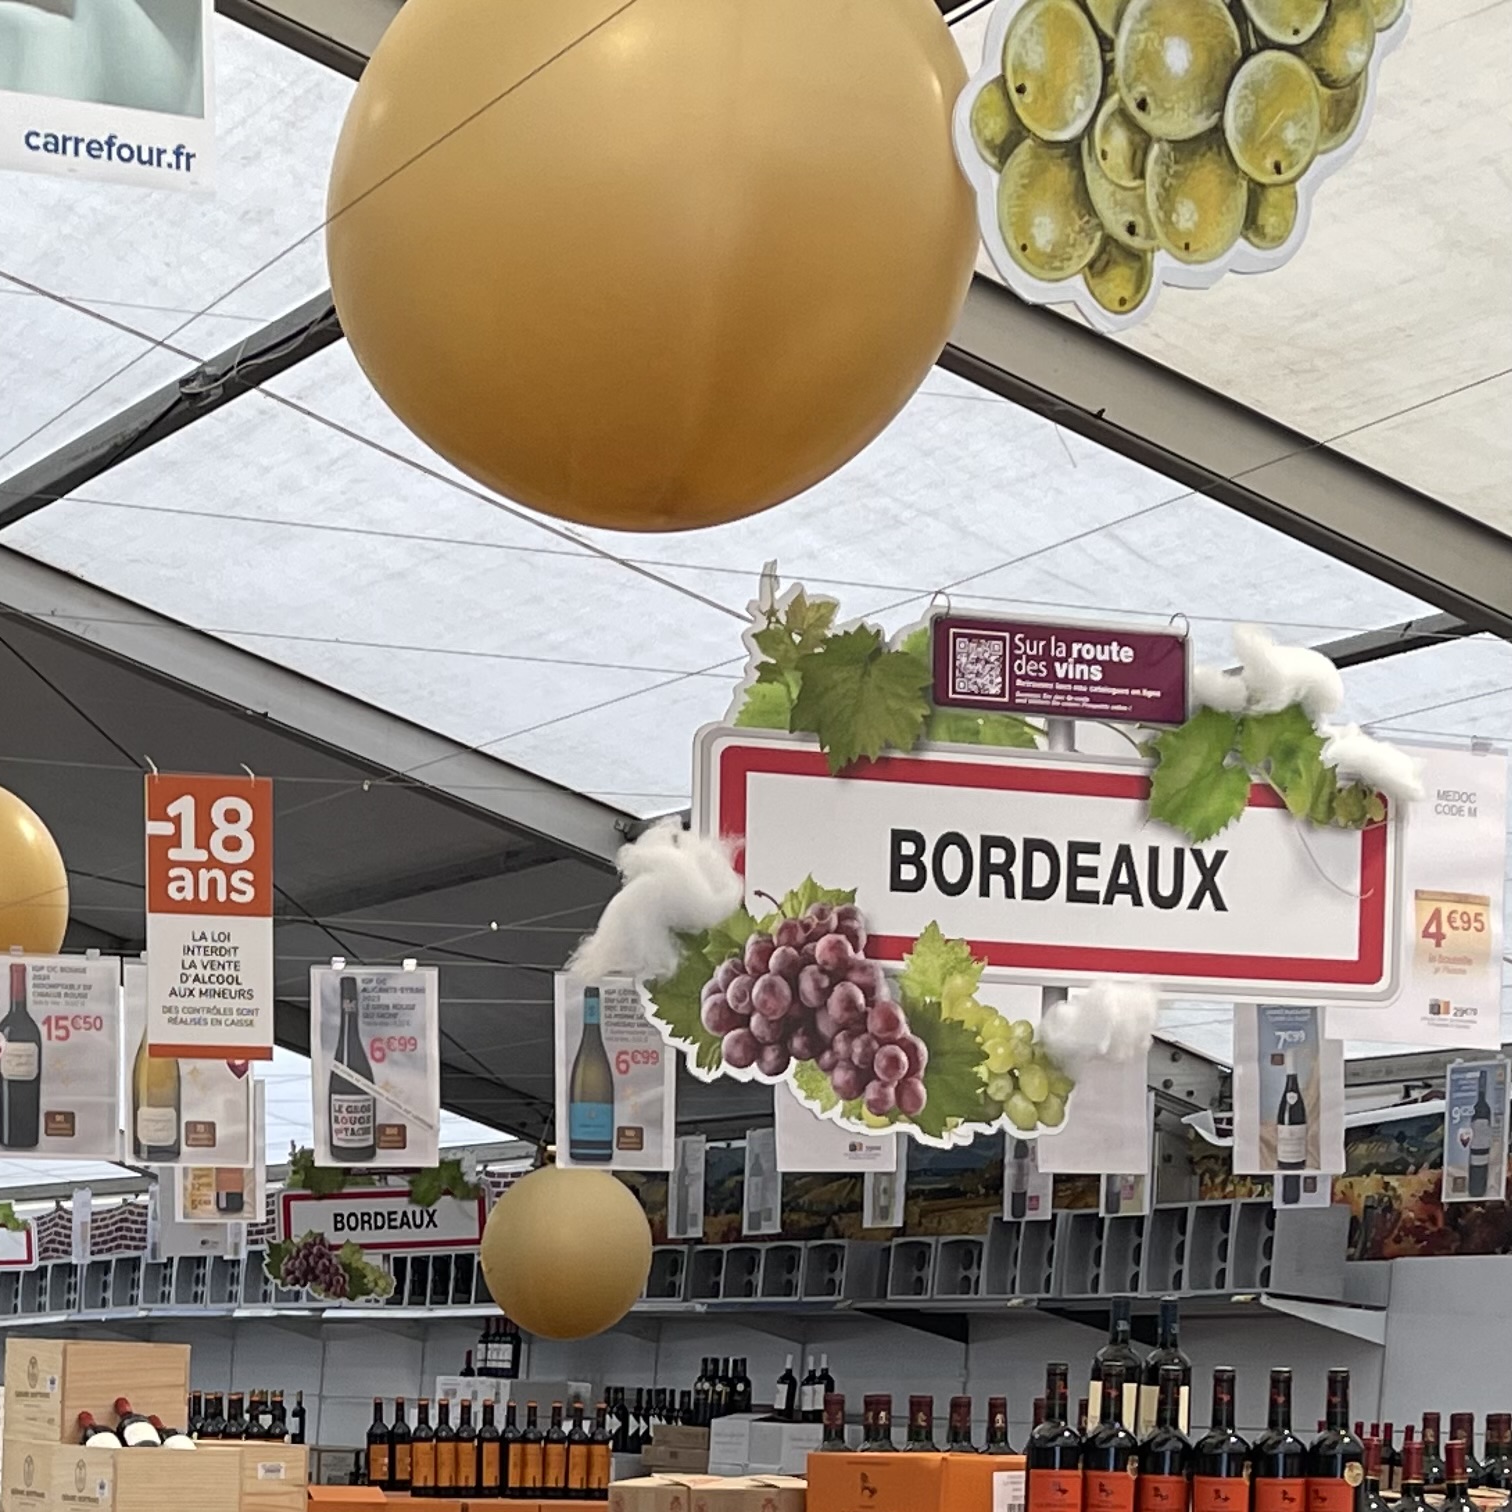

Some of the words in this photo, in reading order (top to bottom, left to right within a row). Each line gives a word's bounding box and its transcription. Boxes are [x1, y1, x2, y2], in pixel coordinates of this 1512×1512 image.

[24, 123, 197, 173] carrefour.fr
[1013, 633, 1044, 656] Sur
[1051, 635, 1068, 658] la
[1071, 641, 1134, 663] route
[1013, 655, 1047, 677] des
[1054, 658, 1103, 681] vins
[1437, 789, 1477, 804] MEDOC
[1434, 803, 1467, 817] CODE
[1469, 806, 1478, 818] M
[147, 794, 256, 864] -18
[889, 828, 1229, 913] BORDEAUX
[166, 866, 256, 904] ans
[191, 930, 208, 942] LA
[211, 930, 231, 943] LOI
[1422, 906, 1485, 948] 4€95
[182, 944, 239, 957] INTERDIT
[181, 959, 197, 970] LA
[201, 959, 241, 971] VENTE
[179, 972, 243, 985] D'ALCOOL
[168, 986, 196, 998] AUX
[199, 987, 254, 1001] MINEURS
[162, 1005, 179, 1014] DES
[181, 1004, 233, 1016] CONTRÔLES
[236, 1007, 260, 1017] SONT
[168, 1015, 208, 1026] RÉALISÉS
[210, 1017, 222, 1026] EN
[224, 1017, 255, 1028] CAISSE
[42, 1014, 103, 1041] 15€50
[369, 1036, 418, 1063] 6€99
[616, 1050, 660, 1075] 6€99
[333, 1208, 439, 1233] BORDEAUX
